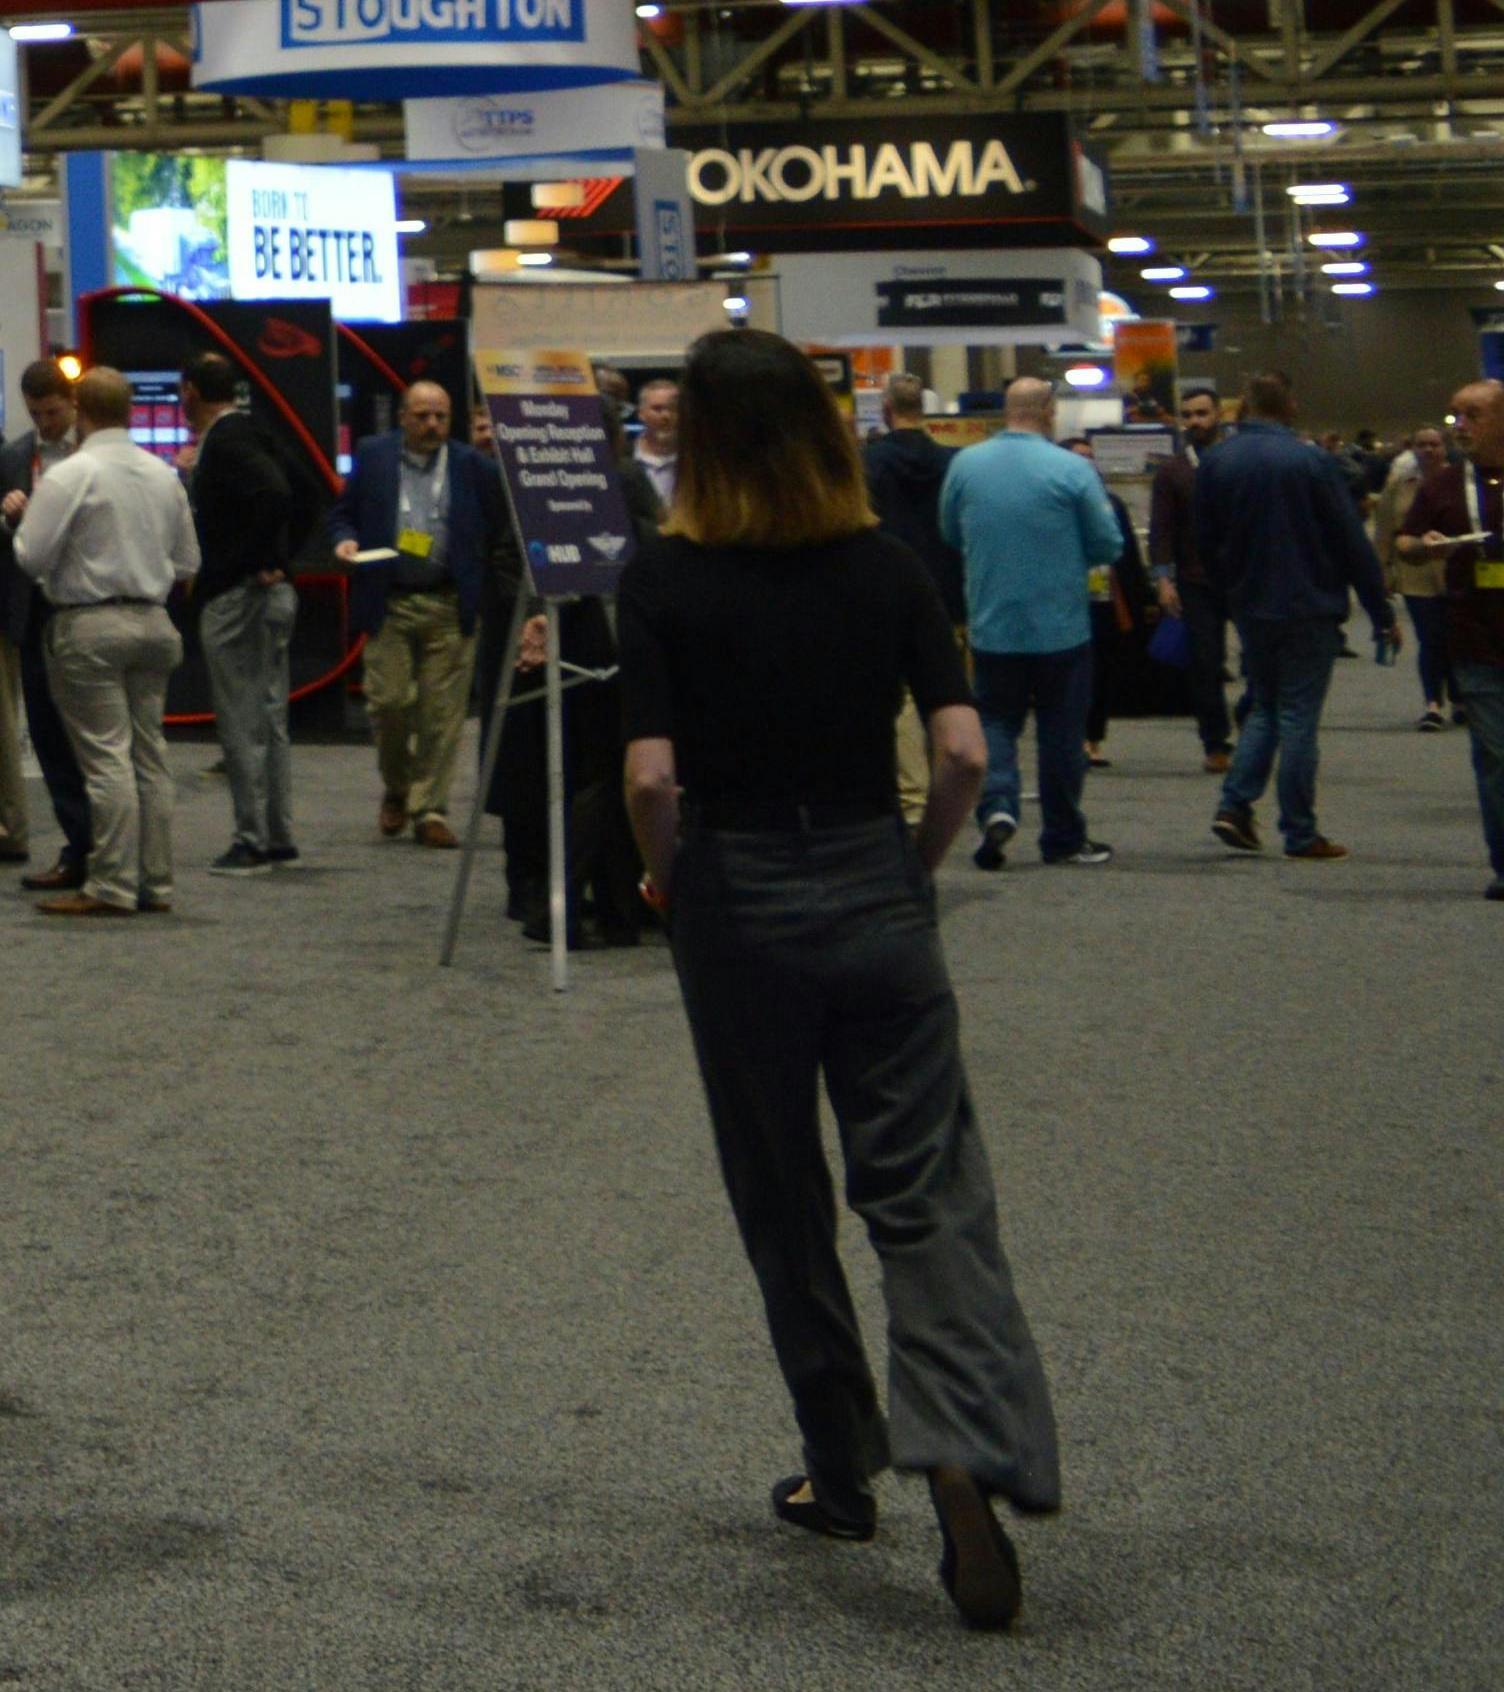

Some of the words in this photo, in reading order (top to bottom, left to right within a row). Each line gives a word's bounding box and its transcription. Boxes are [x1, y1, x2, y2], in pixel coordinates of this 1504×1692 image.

[687, 139, 1025, 206] OKOHAMA
[254, 225, 282, 280] BE
[289, 227, 383, 284] BETTER.
